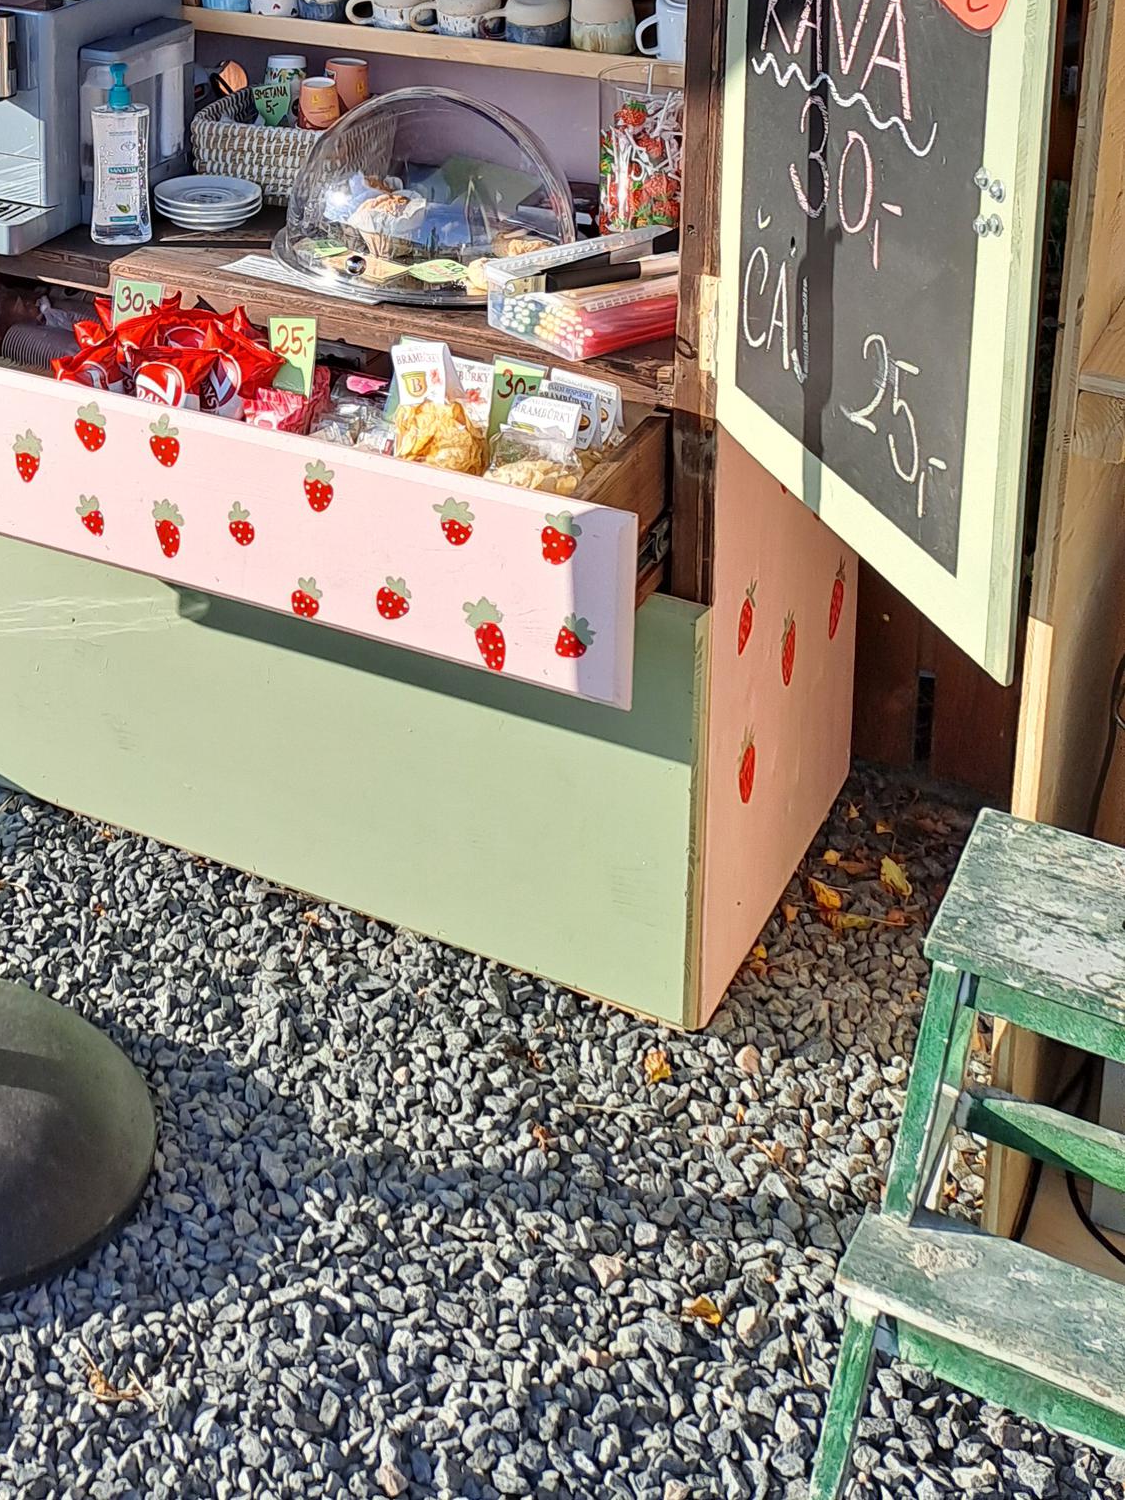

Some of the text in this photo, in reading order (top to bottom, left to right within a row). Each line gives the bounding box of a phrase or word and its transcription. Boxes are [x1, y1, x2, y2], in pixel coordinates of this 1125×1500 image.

[254, 86, 288, 100] SMETANA
[743, 205, 809, 385] ČAJ
[274, 323, 315, 358] 25,-
